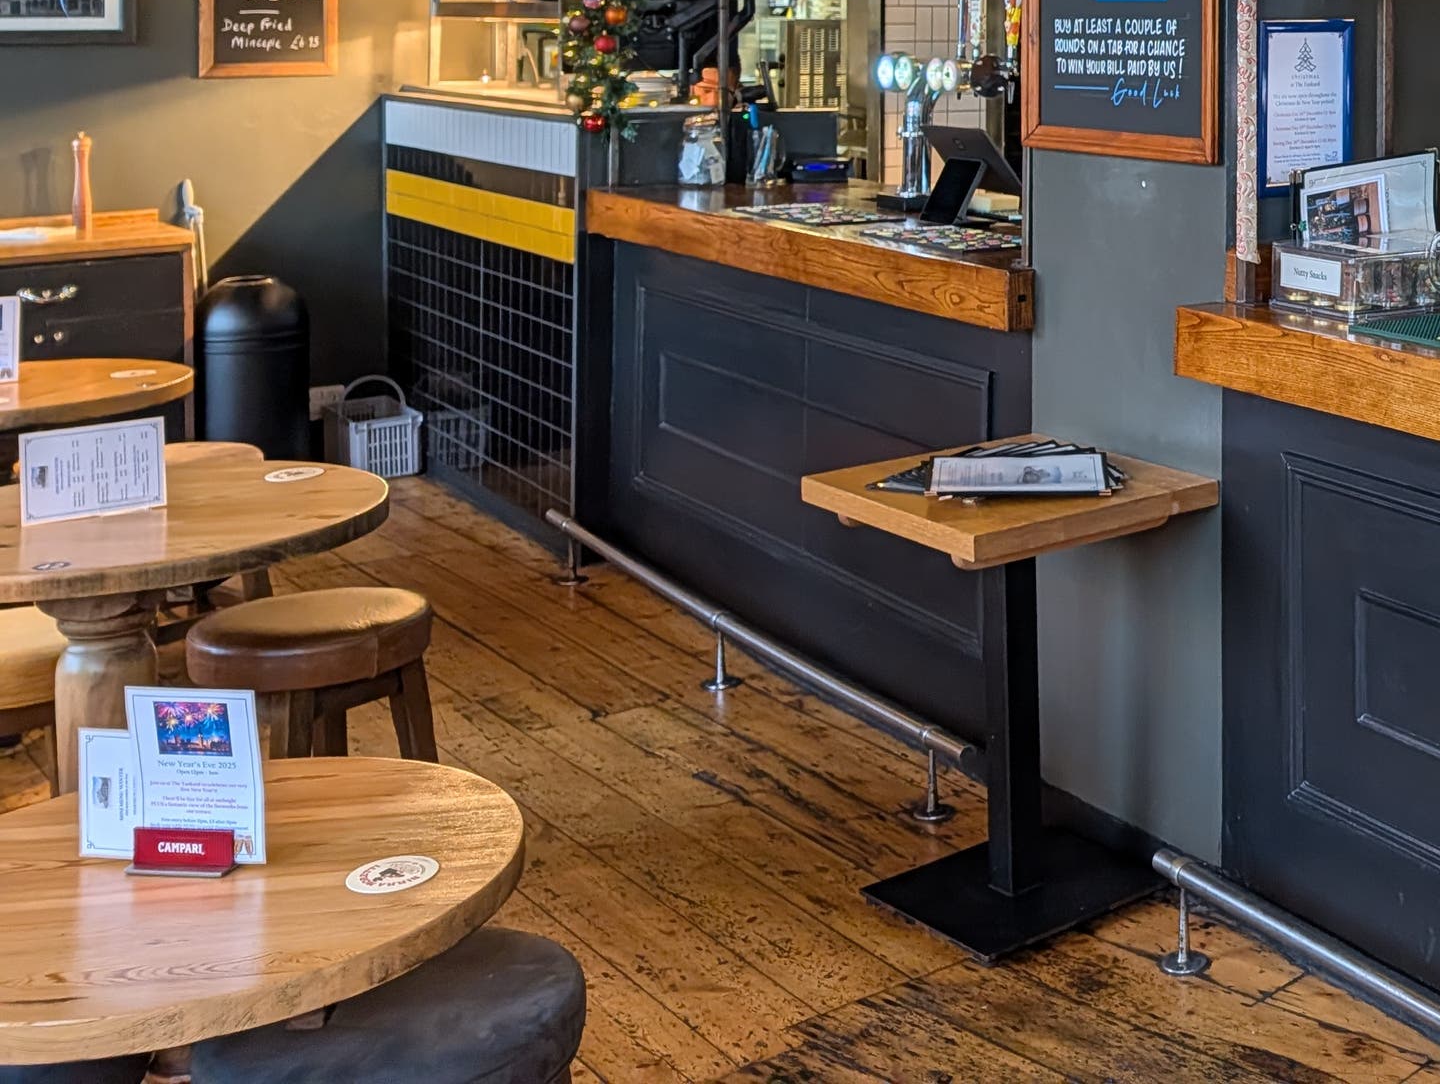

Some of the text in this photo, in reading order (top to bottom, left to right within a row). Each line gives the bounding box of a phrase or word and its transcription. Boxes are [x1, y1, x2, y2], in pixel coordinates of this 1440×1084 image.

[221, 17, 292, 34] Deep Fried
[1074, 19, 1084, 33] AT
[1085, 18, 1113, 34] LEAST
[1115, 19, 1122, 34] A
[1124, 18, 1162, 35] COUPLE
[1054, 39, 1086, 53] ROUNDS
[1087, 40, 1099, 54] ON
[1099, 40, 1107, 54] A
[1107, 40, 1123, 55] TAB
[1140, 40, 1146, 55] A
[1147, 39, 1185, 57] CHANCE
[1056, 58, 1067, 74] TO
[1067, 58, 1085, 74] WIN
[1085, 59, 1107, 75] YOUR
[1107, 59, 1126, 76] BILL
[1127, 60, 1147, 76] PAID
[1147, 60, 1160, 77] BY
[1110, 78, 1148, 106] Good
[1309, 271, 1328, 281] Snacks
[157, 842, 205, 855] CAMPARI
